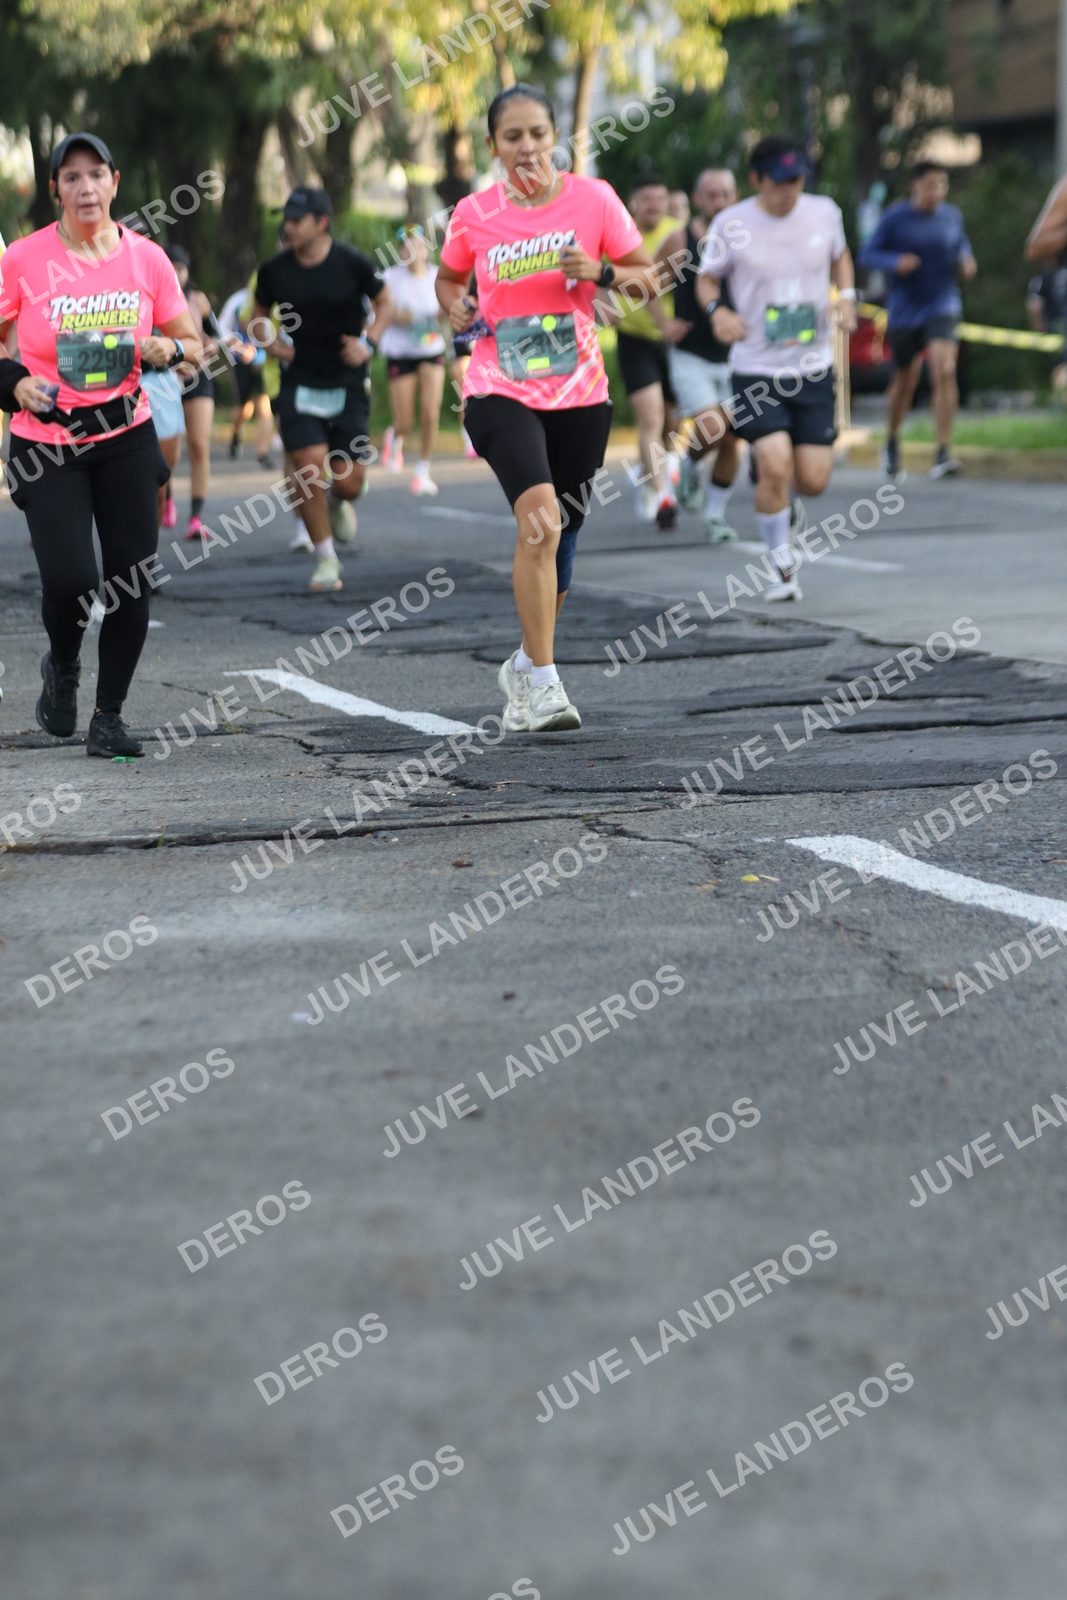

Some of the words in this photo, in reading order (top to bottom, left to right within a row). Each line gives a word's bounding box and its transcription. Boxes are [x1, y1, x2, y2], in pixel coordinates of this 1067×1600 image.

[49, 290, 140, 322] TOCHITOS
[60, 309, 138, 331] RUNNERS
[77, 347, 132, 373] 2290
